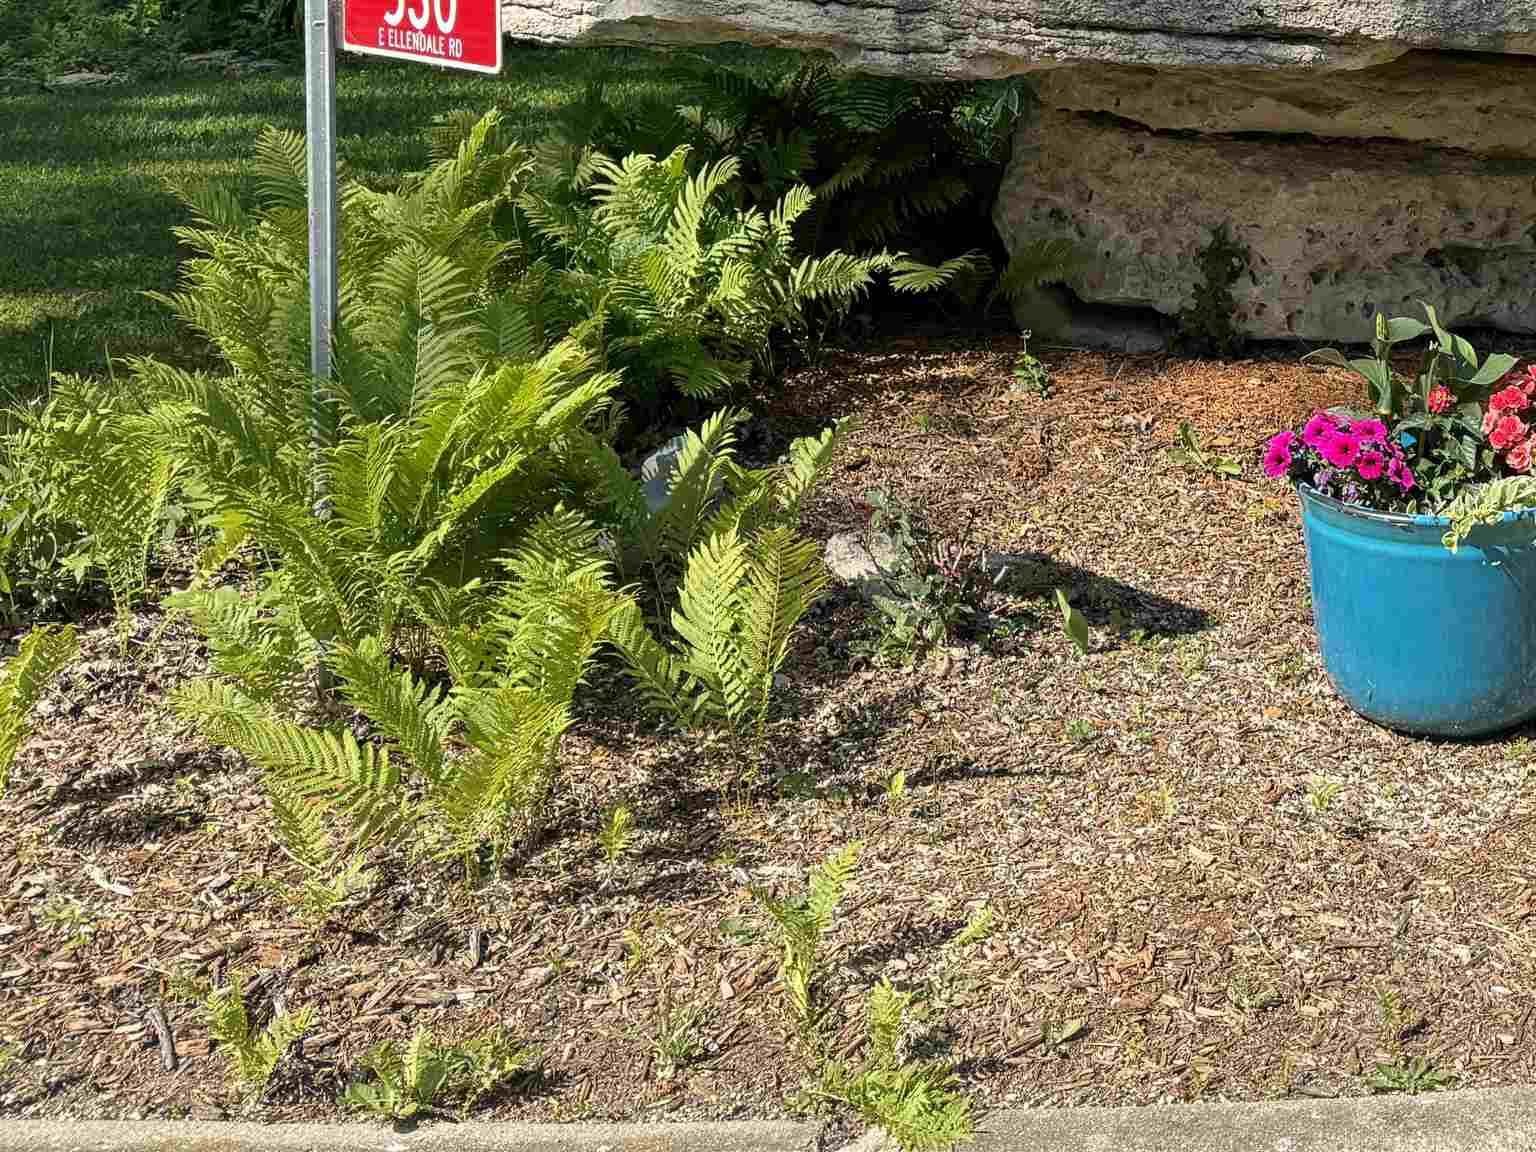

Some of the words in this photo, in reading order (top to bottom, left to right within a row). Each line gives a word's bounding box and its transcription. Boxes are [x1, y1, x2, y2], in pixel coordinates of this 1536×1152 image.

[378, 27, 385, 46] E
[387, 28, 446, 55] ELLENDALE
[448, 37, 463, 58] RD
